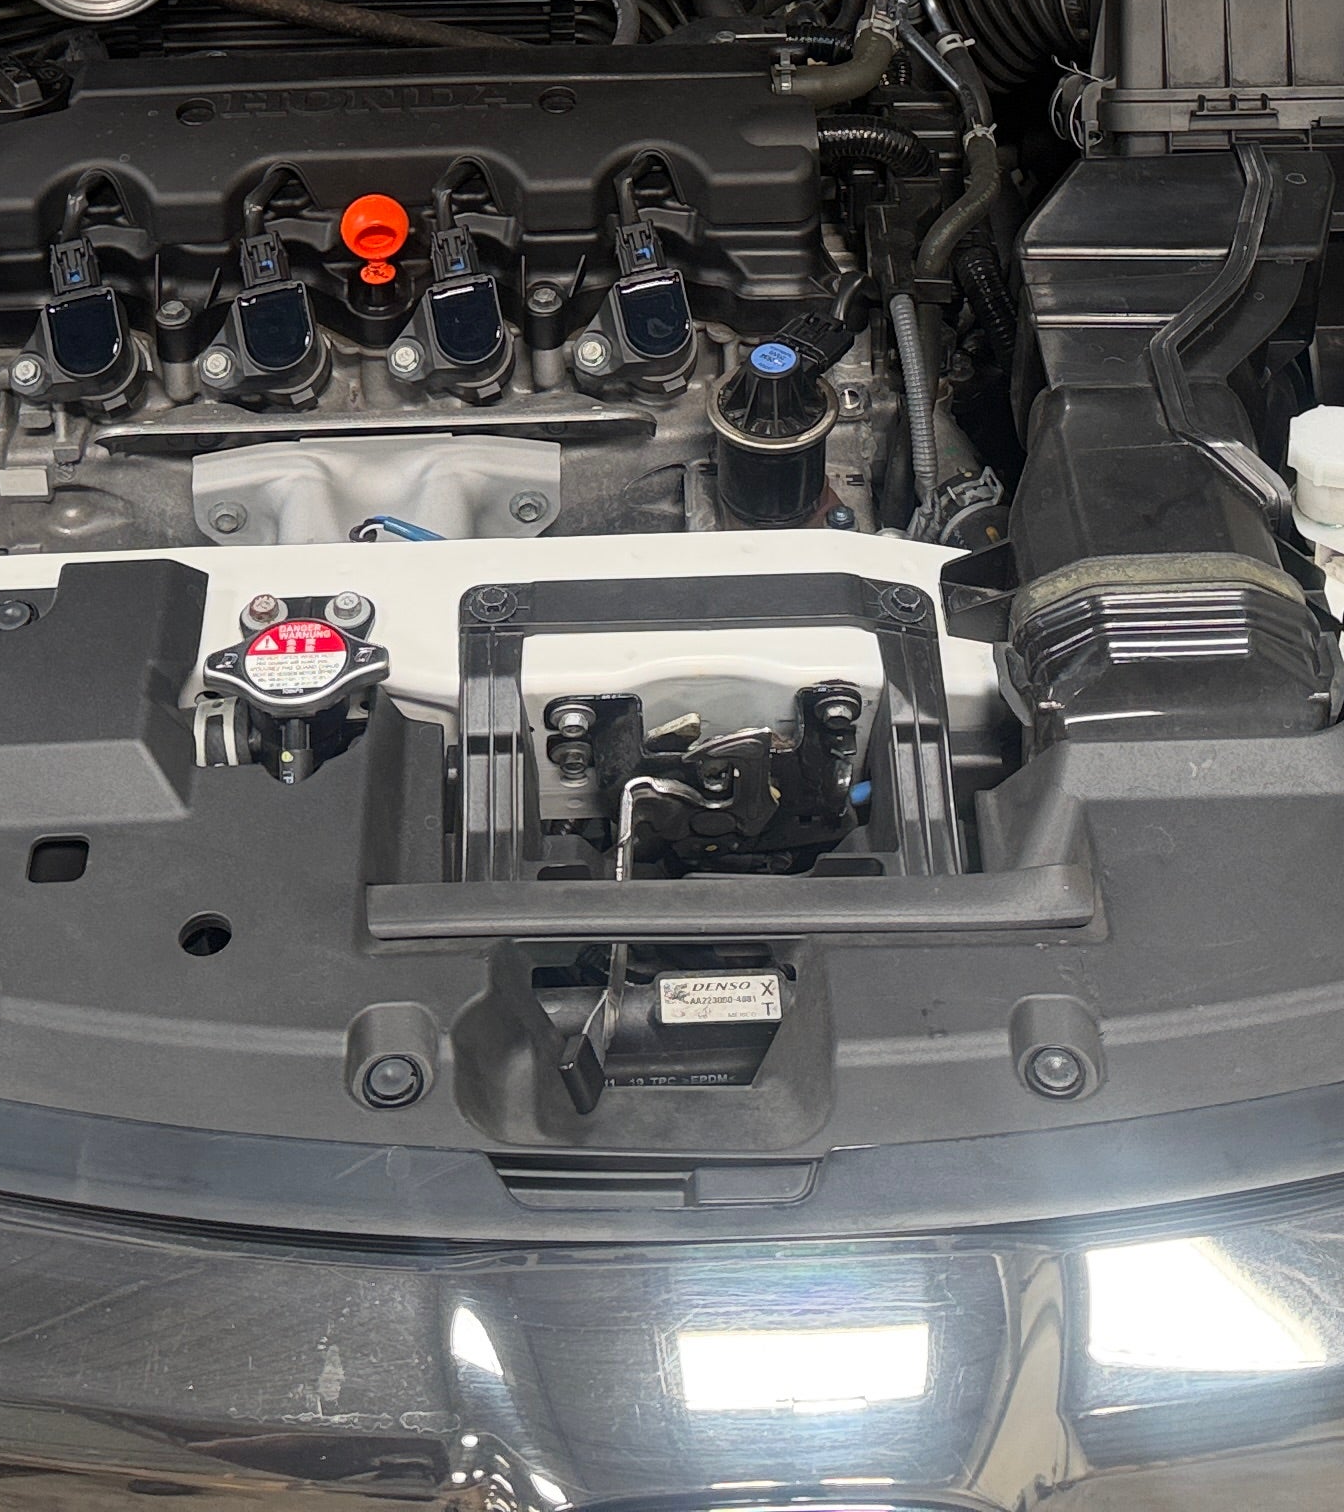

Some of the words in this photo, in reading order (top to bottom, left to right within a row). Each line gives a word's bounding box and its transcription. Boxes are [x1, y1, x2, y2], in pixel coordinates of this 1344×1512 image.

[219, 84, 533, 120] HONDA
[278, 624, 322, 632] DANGER
[692, 981, 751, 992] DENSO
